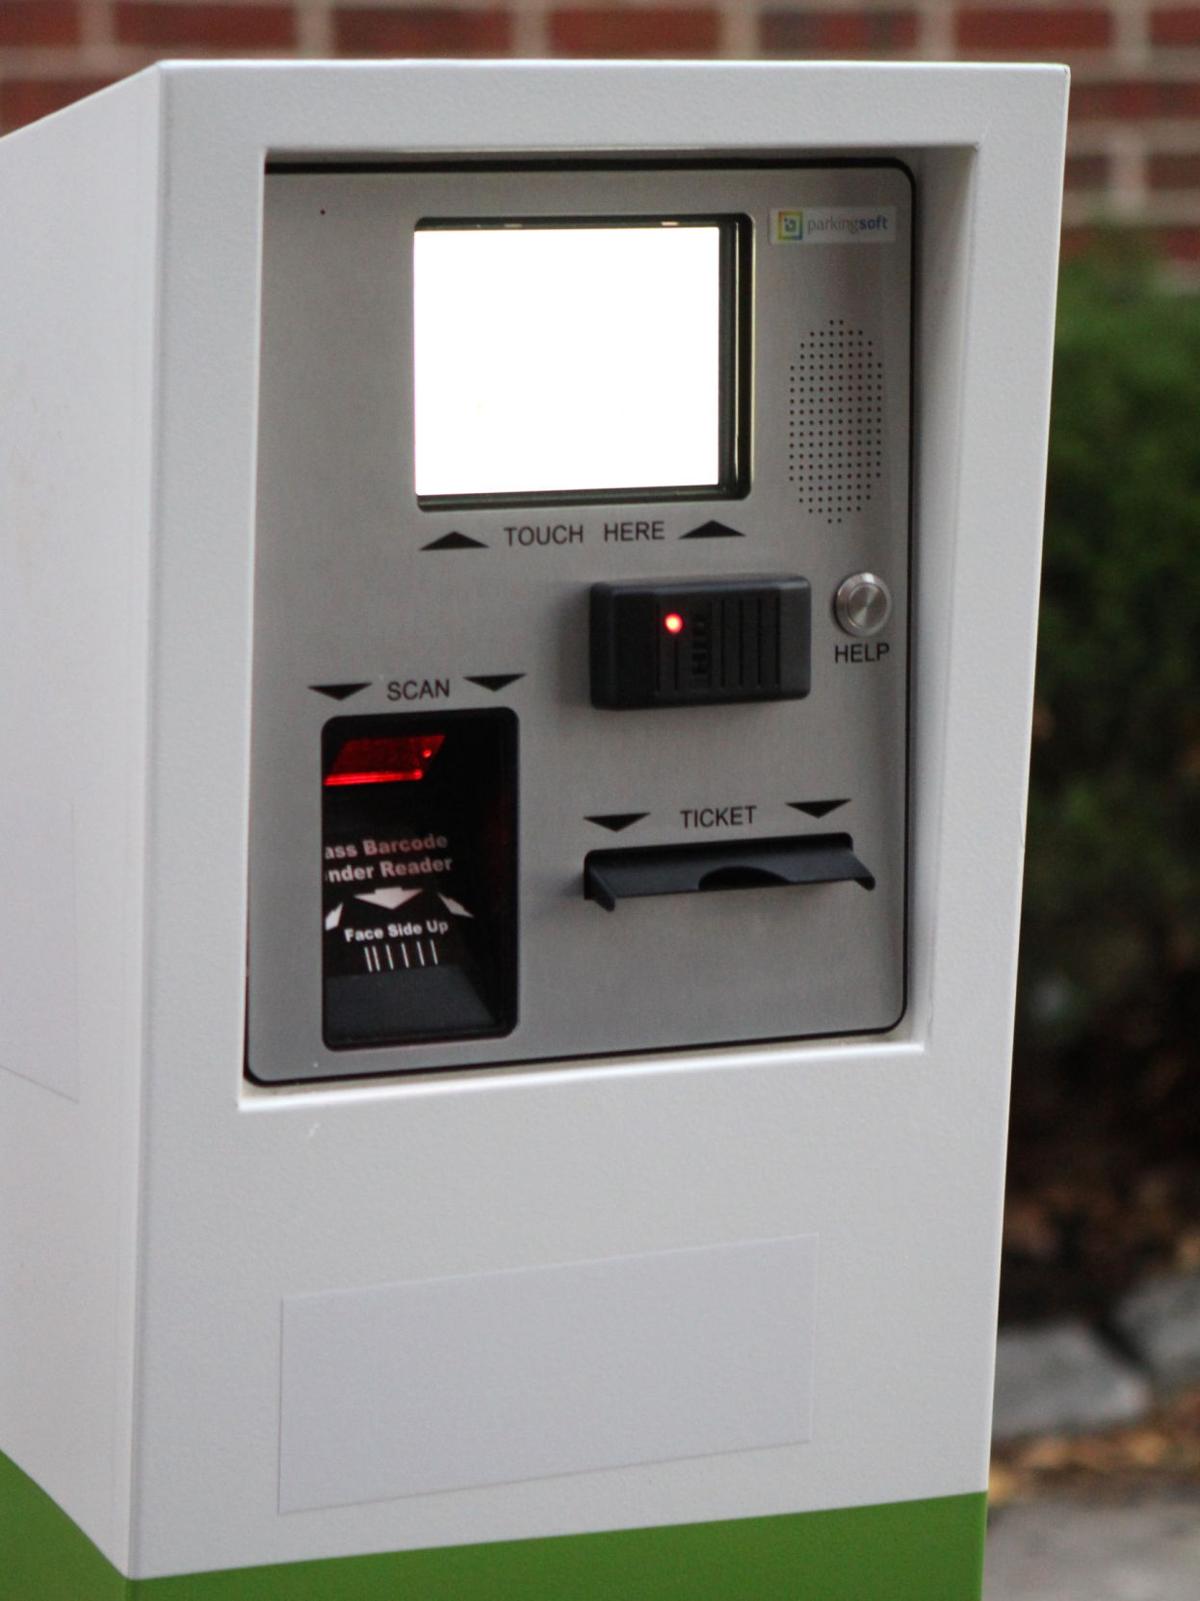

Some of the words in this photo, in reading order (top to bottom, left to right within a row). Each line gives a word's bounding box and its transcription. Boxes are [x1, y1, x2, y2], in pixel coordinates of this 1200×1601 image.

[807, 214, 888, 234] parkingsoft
[503, 524, 584, 546] TOUCH
[603, 521, 665, 542] HERE
[834, 642, 890, 663] HELP
[387, 679, 450, 701] SCAN
[680, 805, 757, 829] TICKET
[324, 843, 358, 860] ass
[362, 833, 448, 856] Barcode
[324, 864, 374, 883] nder
[380, 856, 453, 878] Reader
[344, 926, 384, 942] Face
[387, 921, 423, 938] Side
[426, 918, 449, 935] Up
